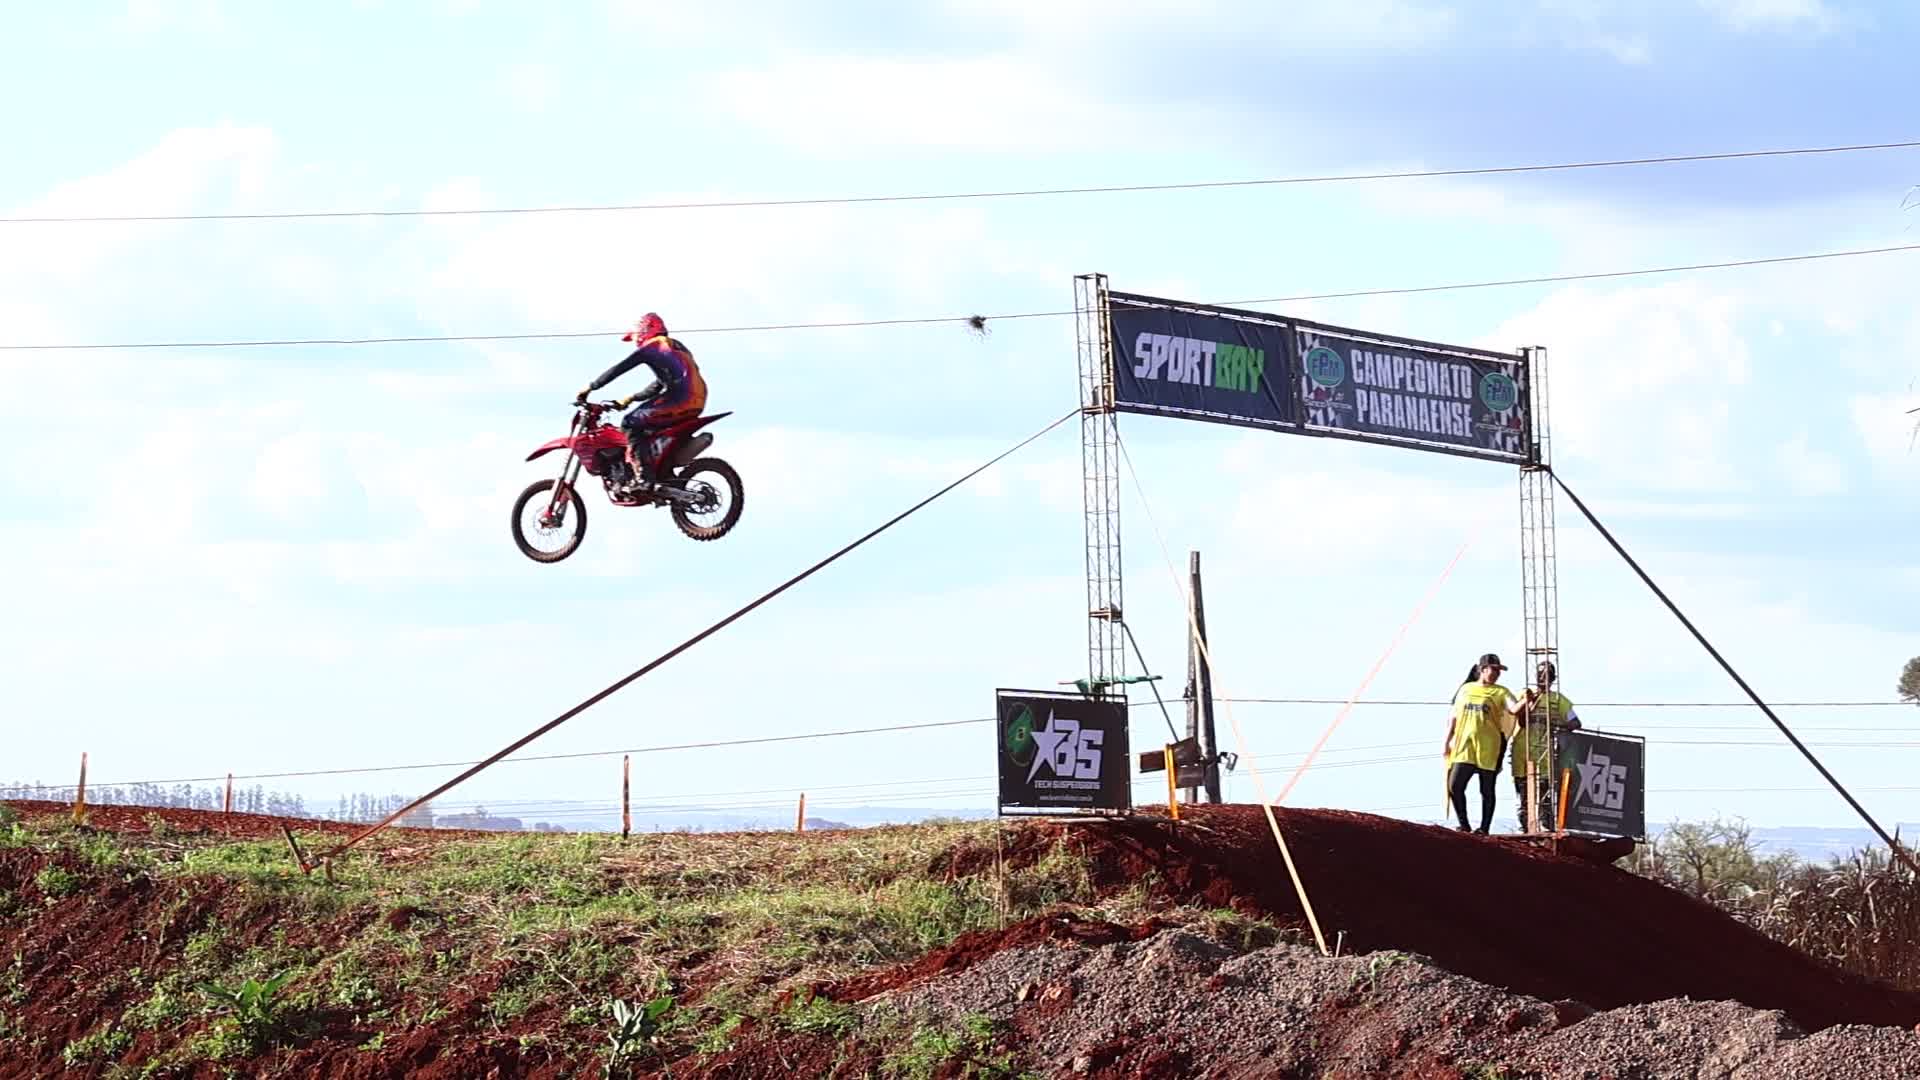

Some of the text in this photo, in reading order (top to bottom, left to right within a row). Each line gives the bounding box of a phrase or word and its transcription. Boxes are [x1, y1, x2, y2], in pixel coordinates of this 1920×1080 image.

[1134, 331, 1264, 393] SPORTBAY
[1350, 348, 1472, 398] CAMPEONATO
[1355, 388, 1473, 438] PARANAENSE
